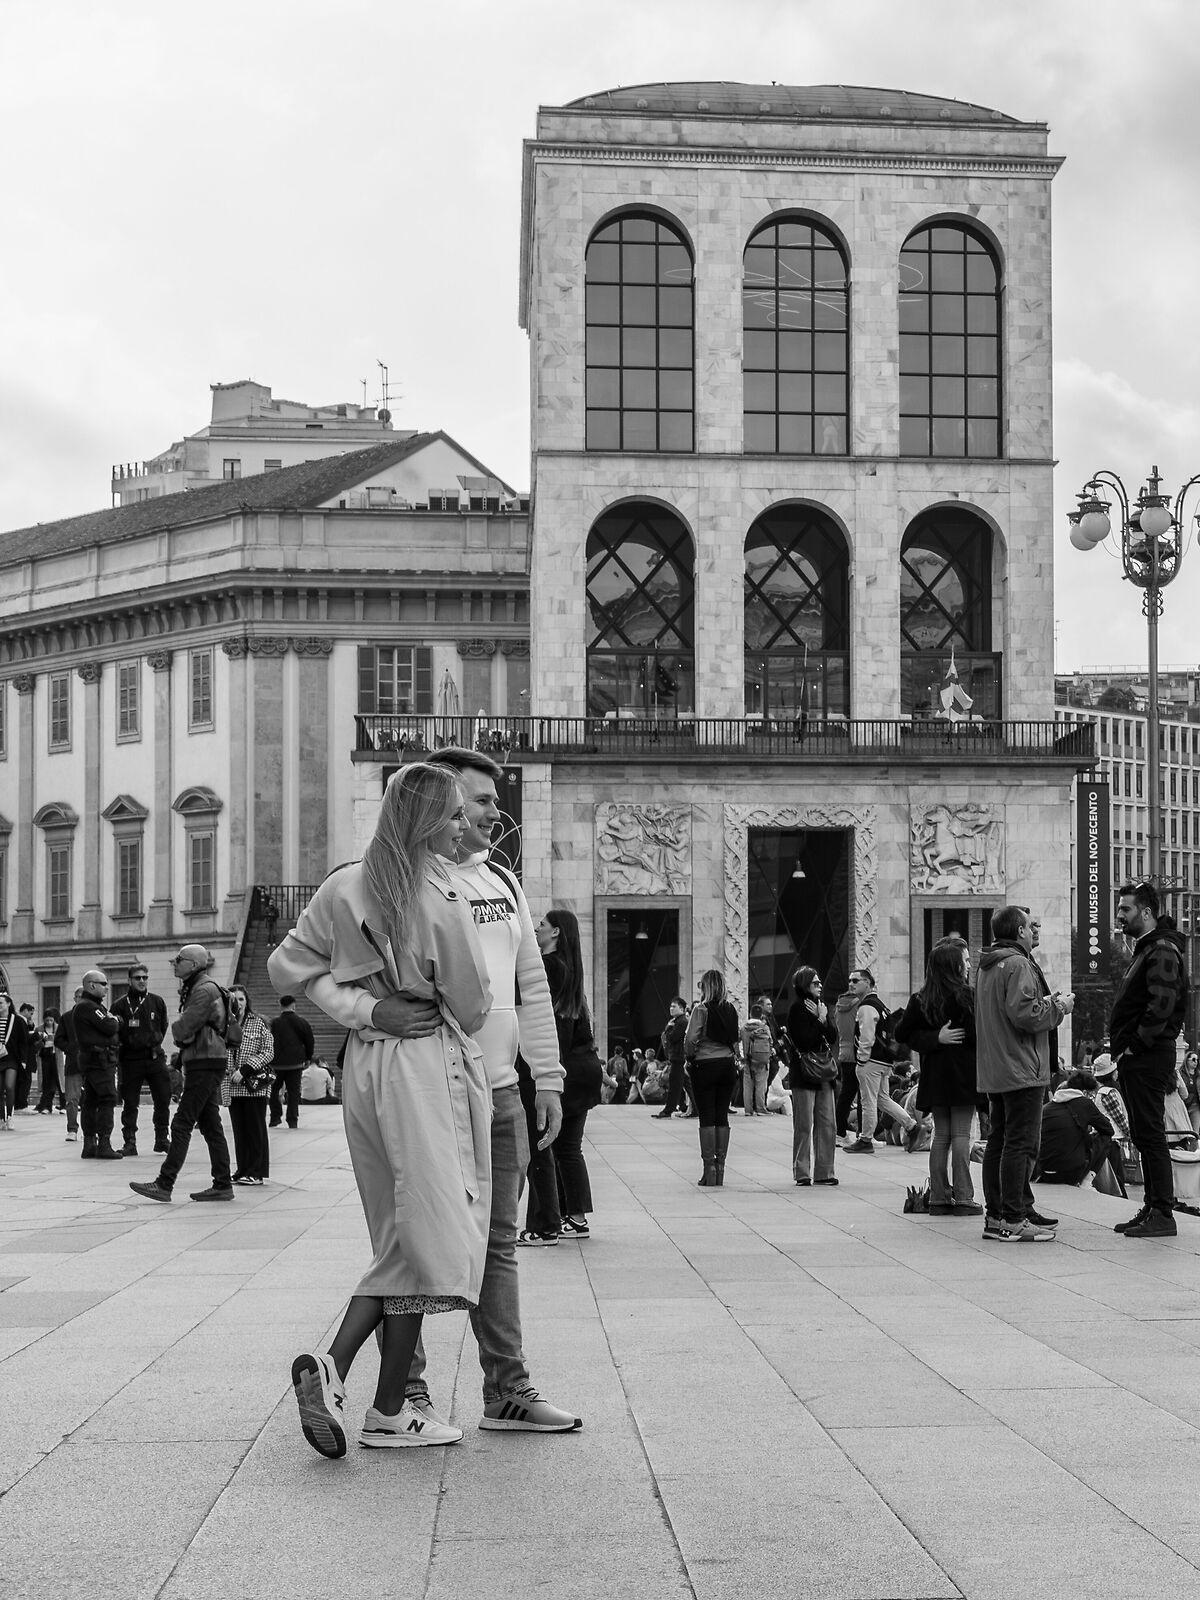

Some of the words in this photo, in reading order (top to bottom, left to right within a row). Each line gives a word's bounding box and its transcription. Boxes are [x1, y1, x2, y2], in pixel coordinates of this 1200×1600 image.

[1088, 791, 1099, 859] NOVECENTO
[1088, 861, 1099, 882] DEL
[472, 903, 507, 916] OMMY
[1088, 884, 1099, 924] MUSEO
[406, 1419, 425, 1433] N
